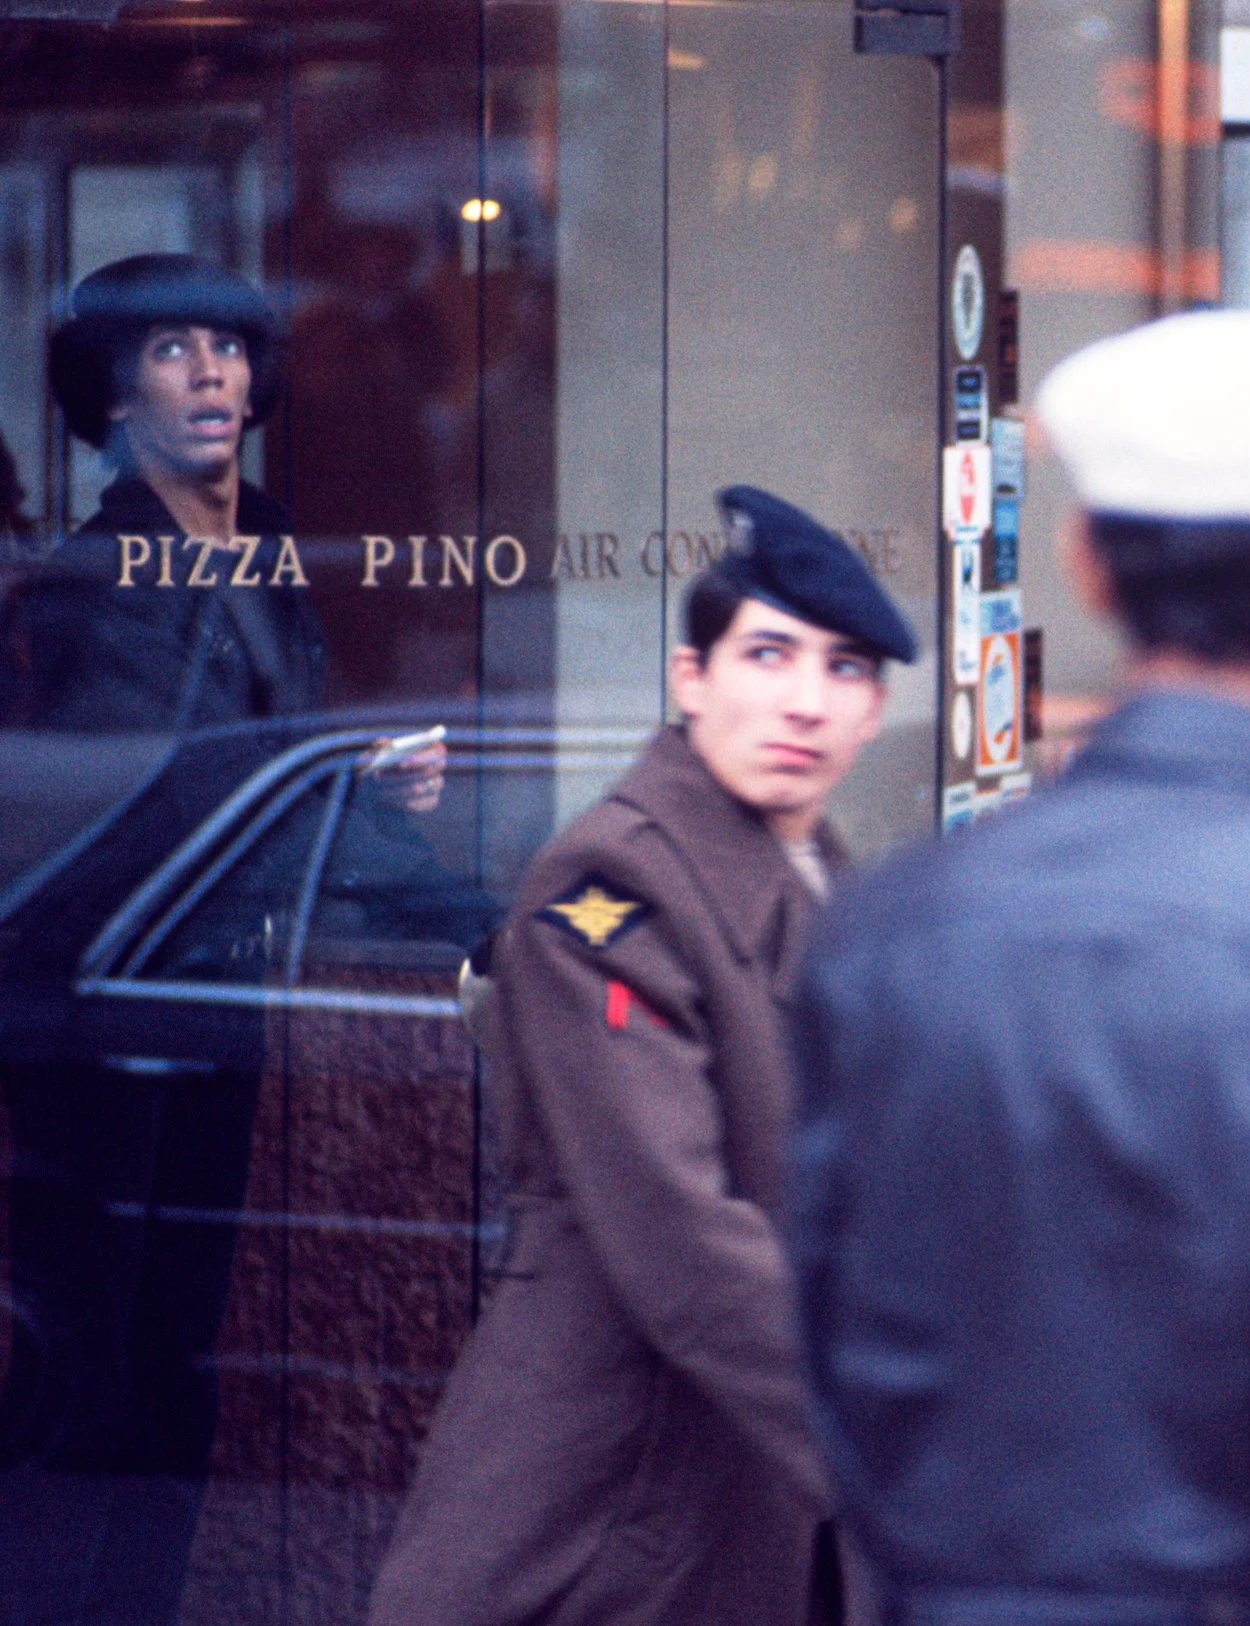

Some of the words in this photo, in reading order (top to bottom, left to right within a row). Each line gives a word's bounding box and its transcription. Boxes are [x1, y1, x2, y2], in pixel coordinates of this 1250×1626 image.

[116, 534, 310, 587] PIZZA
[360, 534, 527, 587] PINO
[552, 532, 621, 579] AIR
